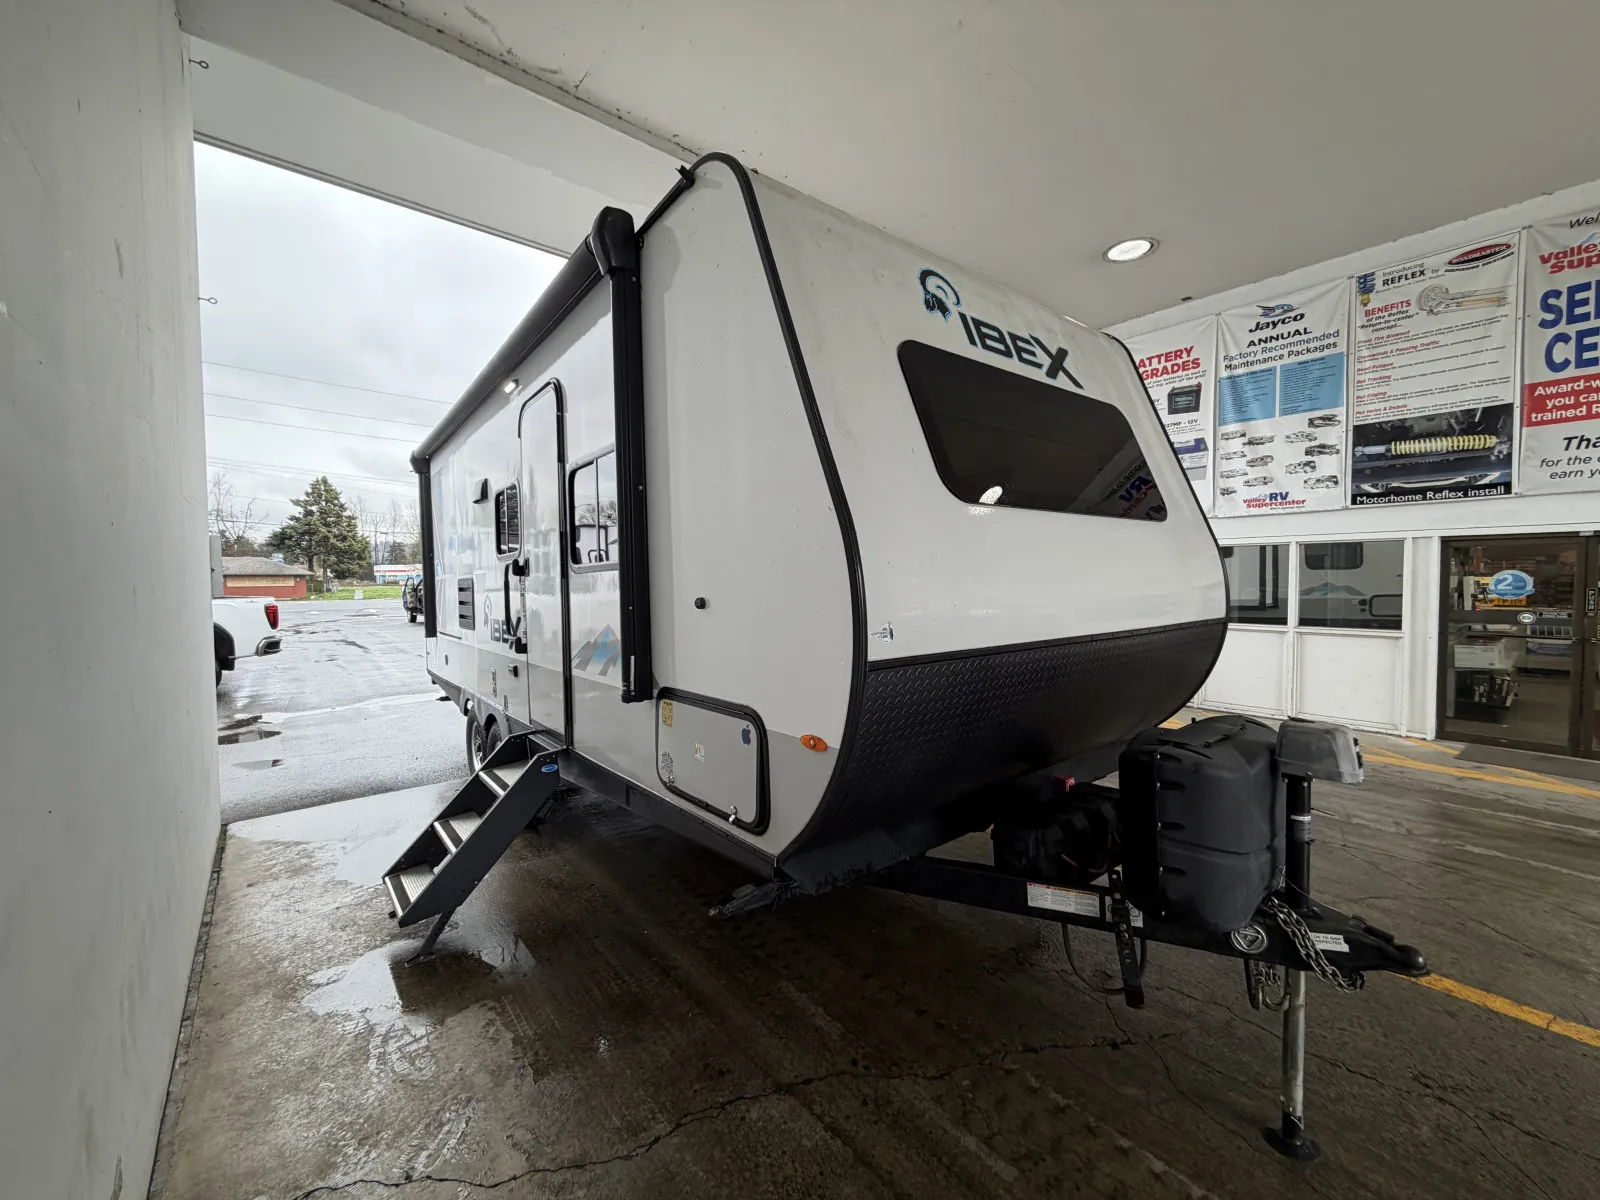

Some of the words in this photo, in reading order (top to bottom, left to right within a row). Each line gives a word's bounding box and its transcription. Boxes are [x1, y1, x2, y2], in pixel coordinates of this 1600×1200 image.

[1452, 246, 1508, 263] ROADMASTER
[1382, 262, 1424, 277] Introducing
[1364, 299, 1412, 318] BENEFITS
[1538, 280, 1600, 329] SE
[1248, 313, 1305, 333] Jayco
[1375, 313, 1385, 321] the
[1387, 309, 1410, 318] Reflex
[1246, 327, 1313, 349] ANNUAL
[1385, 329, 1410, 338] Blowout
[957, 311, 1084, 390] IBEX
[1223, 350, 1259, 363] Factory
[1261, 329, 1340, 355] Recommended
[1356, 350, 1388, 360] Crosswinds
[1394, 344, 1418, 353] Passing
[1419, 339, 1439, 348] Traffic
[1224, 353, 1285, 372] Maintenance
[1287, 341, 1338, 358] Packages
[1371, 361, 1393, 370] Fatigue
[1163, 374, 1183, 382] batteries
[1367, 374, 1391, 382] Tracking
[1546, 396, 1575, 409] you
[1579, 393, 1600, 403] ca
[1531, 405, 1587, 422] trained
[1540, 458, 1563, 468] for
[1567, 455, 1592, 466] the
[1549, 470, 1584, 480] earn
[1269, 491, 1289, 502] RV
[1356, 493, 1423, 505] Motorhome
[1426, 489, 1464, 500] Reflex
[1468, 485, 1505, 497] install
[1246, 499, 1307, 509] Supercenter
[1496, 574, 1513, 590] 2
